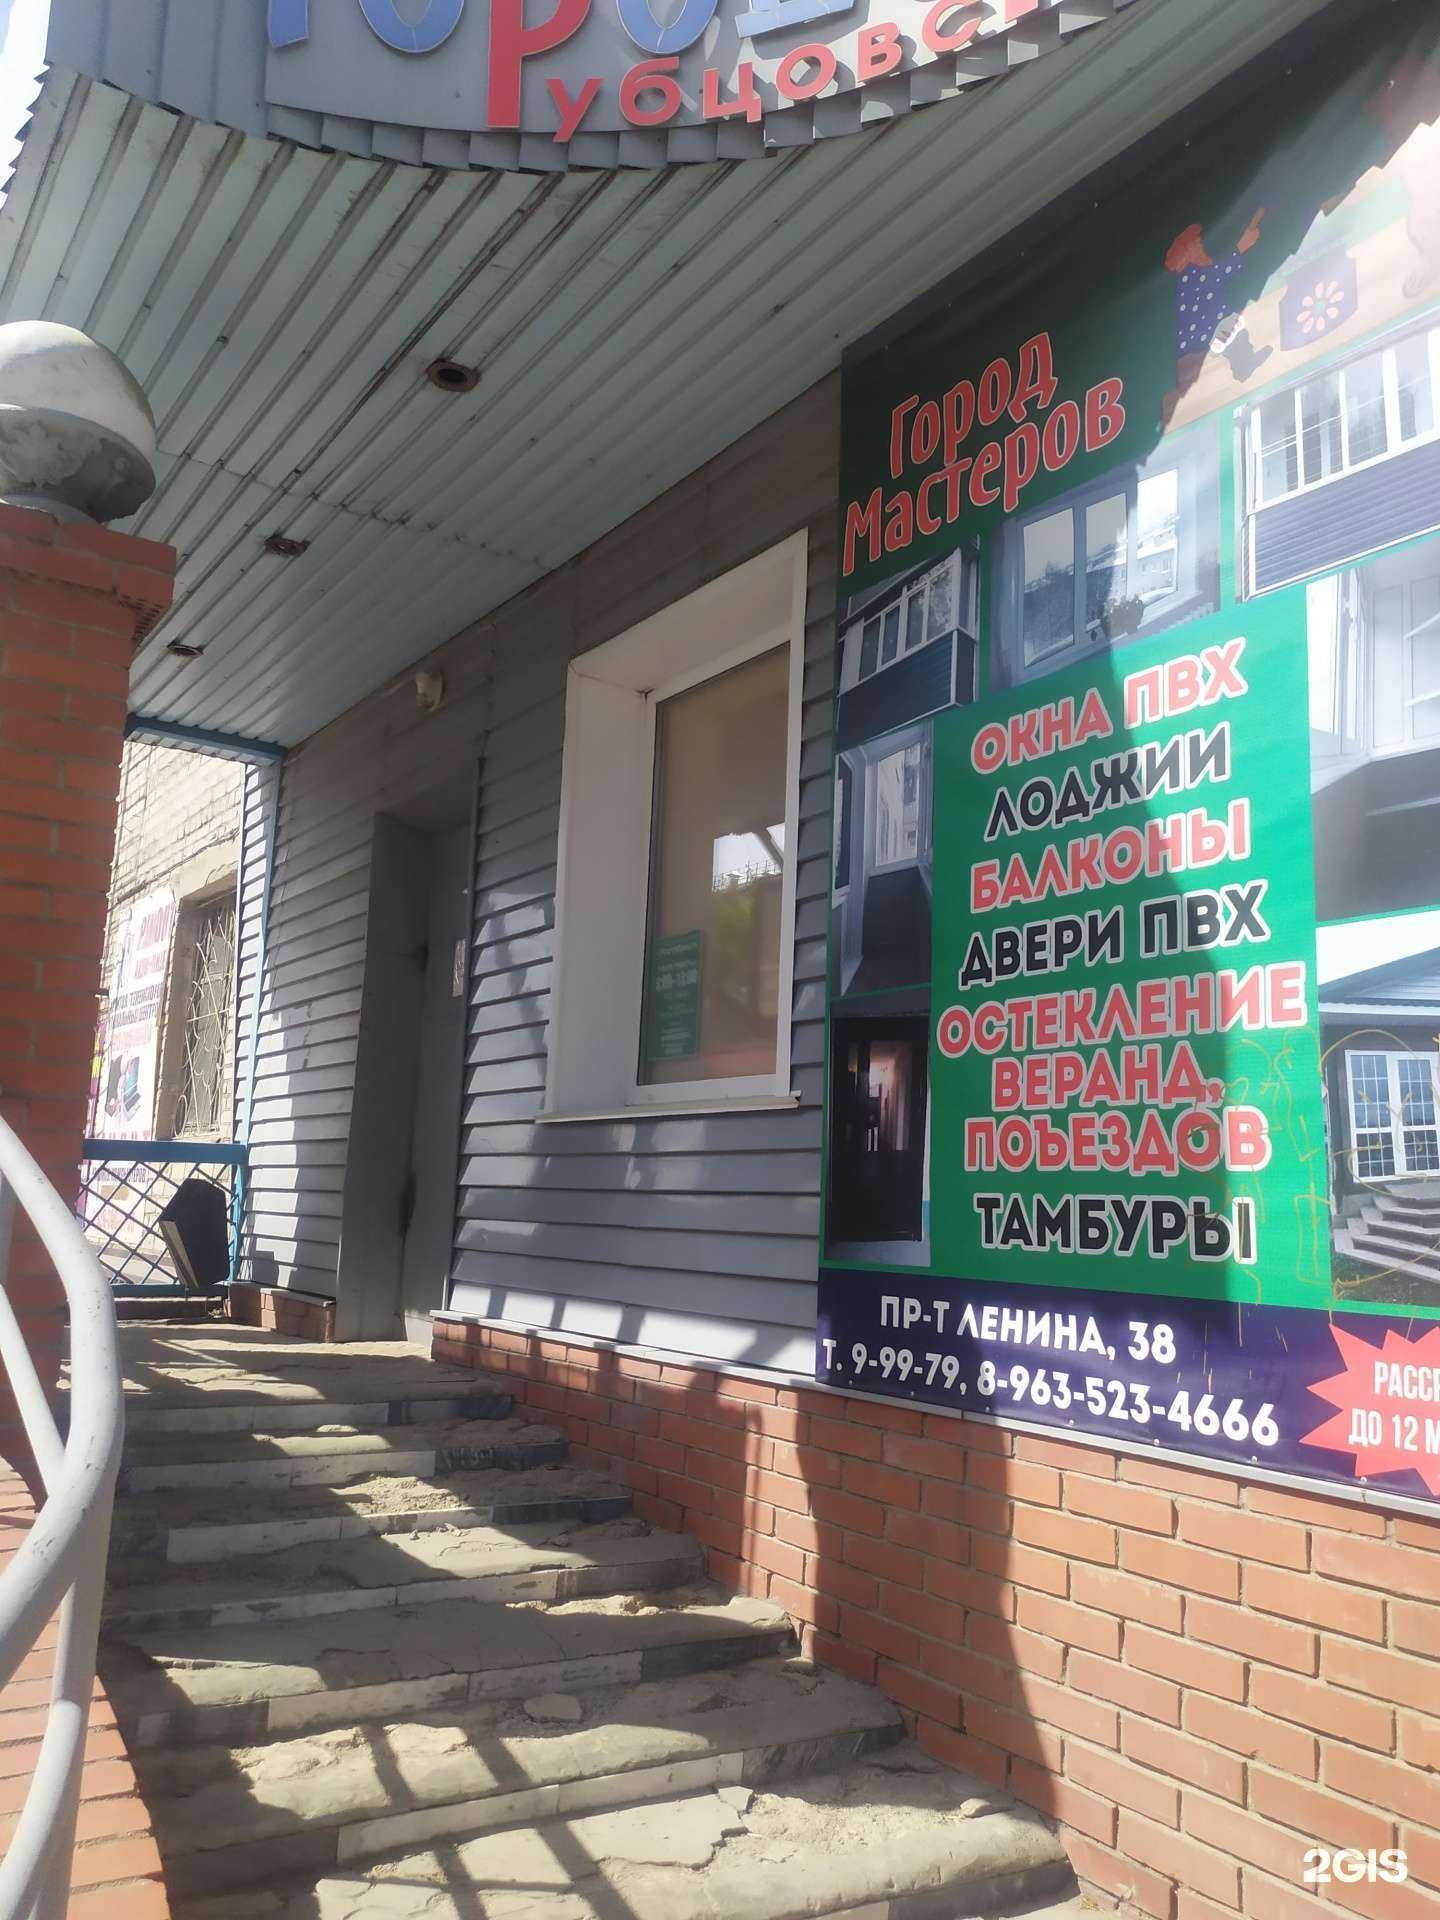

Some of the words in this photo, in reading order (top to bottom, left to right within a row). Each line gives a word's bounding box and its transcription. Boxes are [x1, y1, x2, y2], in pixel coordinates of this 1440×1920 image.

[843, 378, 1126, 577] Мастеров
[971, 687, 1112, 774] ОКНА
[1124, 637, 1248, 728] ПВХ
[984, 721, 1231, 842] ЛОДЖИИ
[970, 798, 1251, 913] БАЛКОНЫ
[958, 904, 1124, 988] ДВЕРИ
[1140, 879, 1272, 959] ПВХ
[937, 961, 1308, 1058] ОСТЕКЛЕНИЕ
[973, 1190, 1258, 1265] ТАМБУРЫ
[880, 1295, 950, 1334] ПР-Т
[956, 1303, 1117, 1362] ЛЕНИНА,
[1127, 1320, 1177, 1365] 38
[822, 1338, 844, 1371] Т.
[851, 1342, 969, 1396] 9-99-79,
[976, 1360, 1280, 1447] 8-963-523-4666
[1348, 1407, 1383, 1448] ДО
[1392, 1414, 1419, 1452] 12
